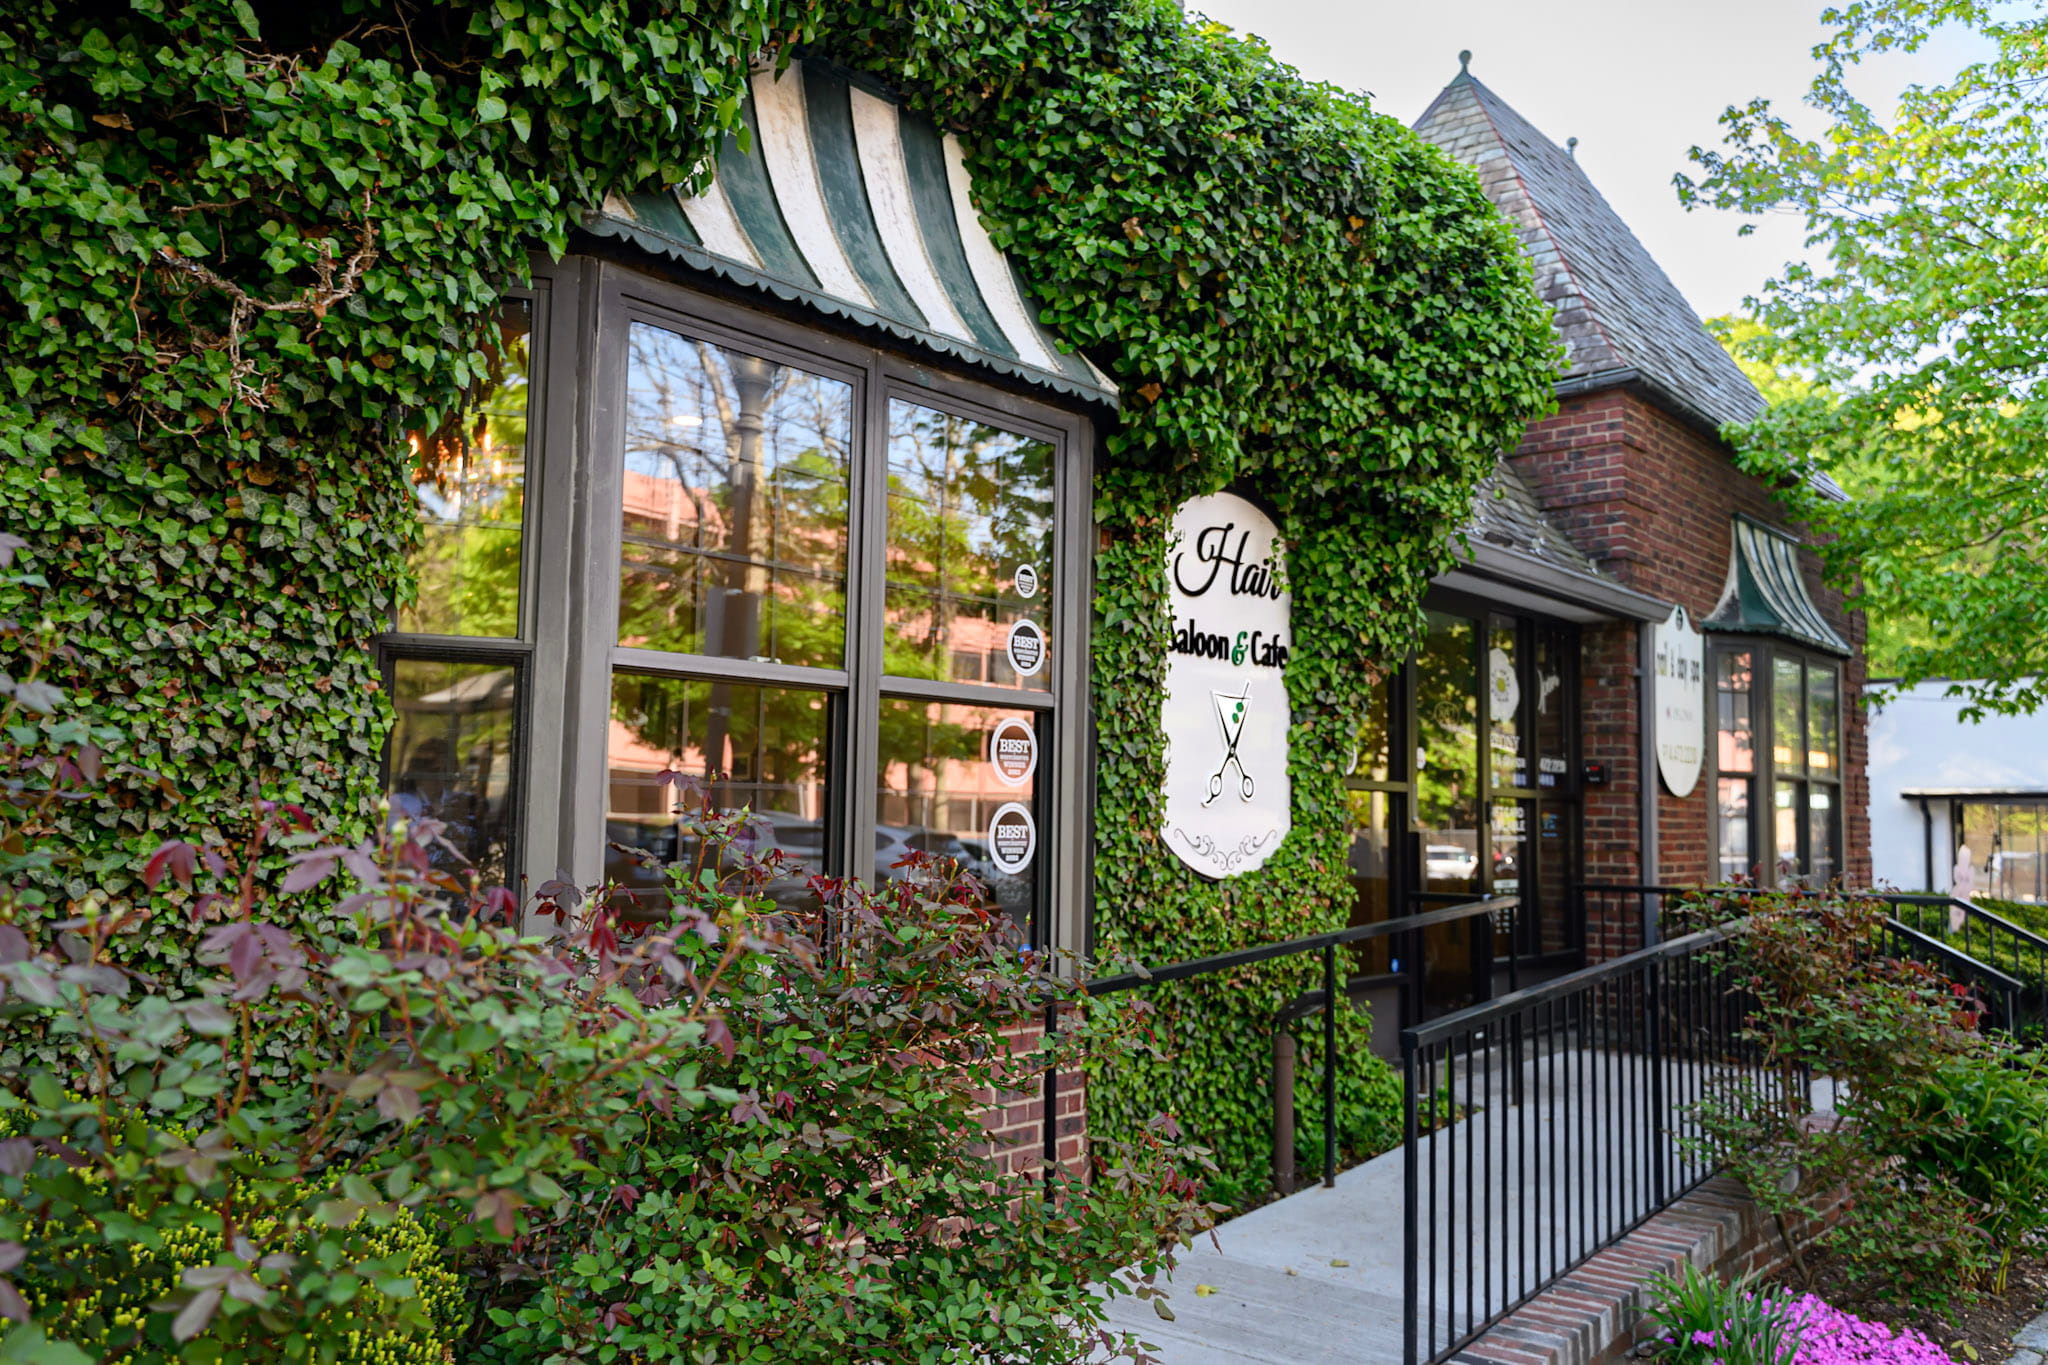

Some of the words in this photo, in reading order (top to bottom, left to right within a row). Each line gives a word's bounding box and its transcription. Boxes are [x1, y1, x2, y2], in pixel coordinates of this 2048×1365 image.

[1013, 635, 1039, 650] BEST
[1231, 630, 1249, 666] &
[1251, 630, 1289, 669] Cafe
[999, 738, 1031, 753] BEST
[997, 824, 1028, 839] BEST
